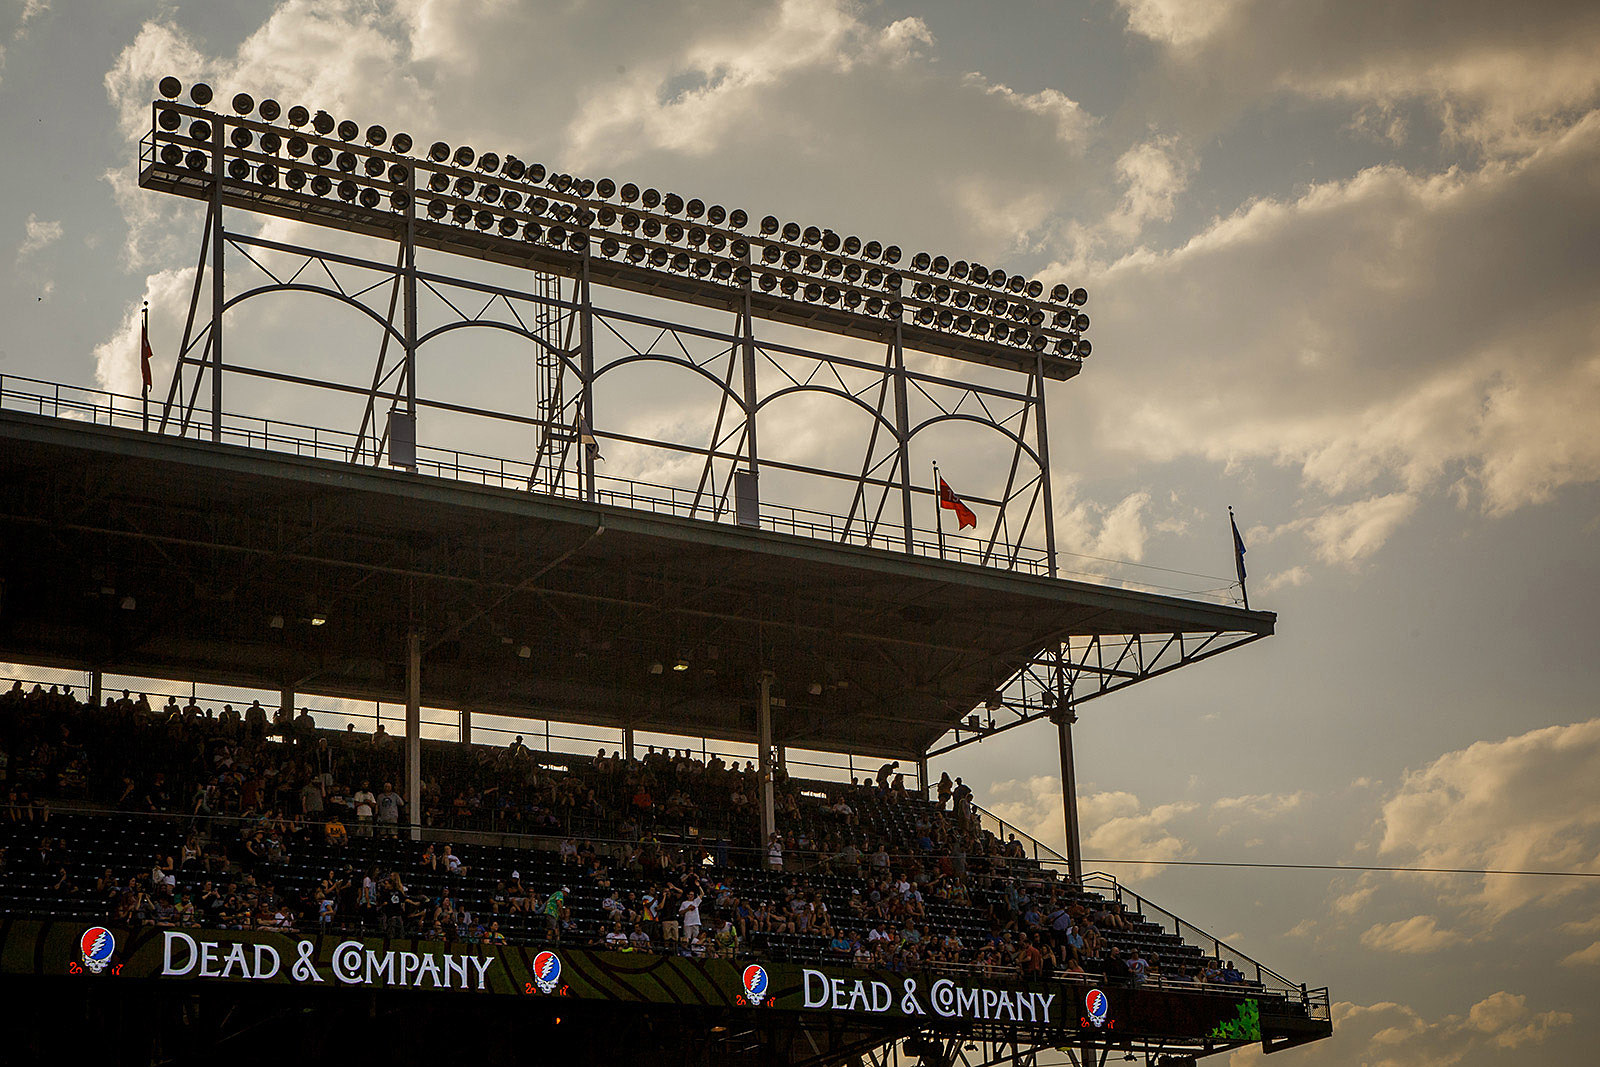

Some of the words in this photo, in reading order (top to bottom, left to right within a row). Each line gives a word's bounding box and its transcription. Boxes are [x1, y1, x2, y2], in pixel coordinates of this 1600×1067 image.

[160, 931, 281, 979] DEAD
[292, 940, 325, 982] &
[332, 941, 495, 990] COMPANY
[803, 969, 892, 1012] DEAD
[900, 977, 927, 1016] &
[931, 979, 1057, 1024] COMPANY
